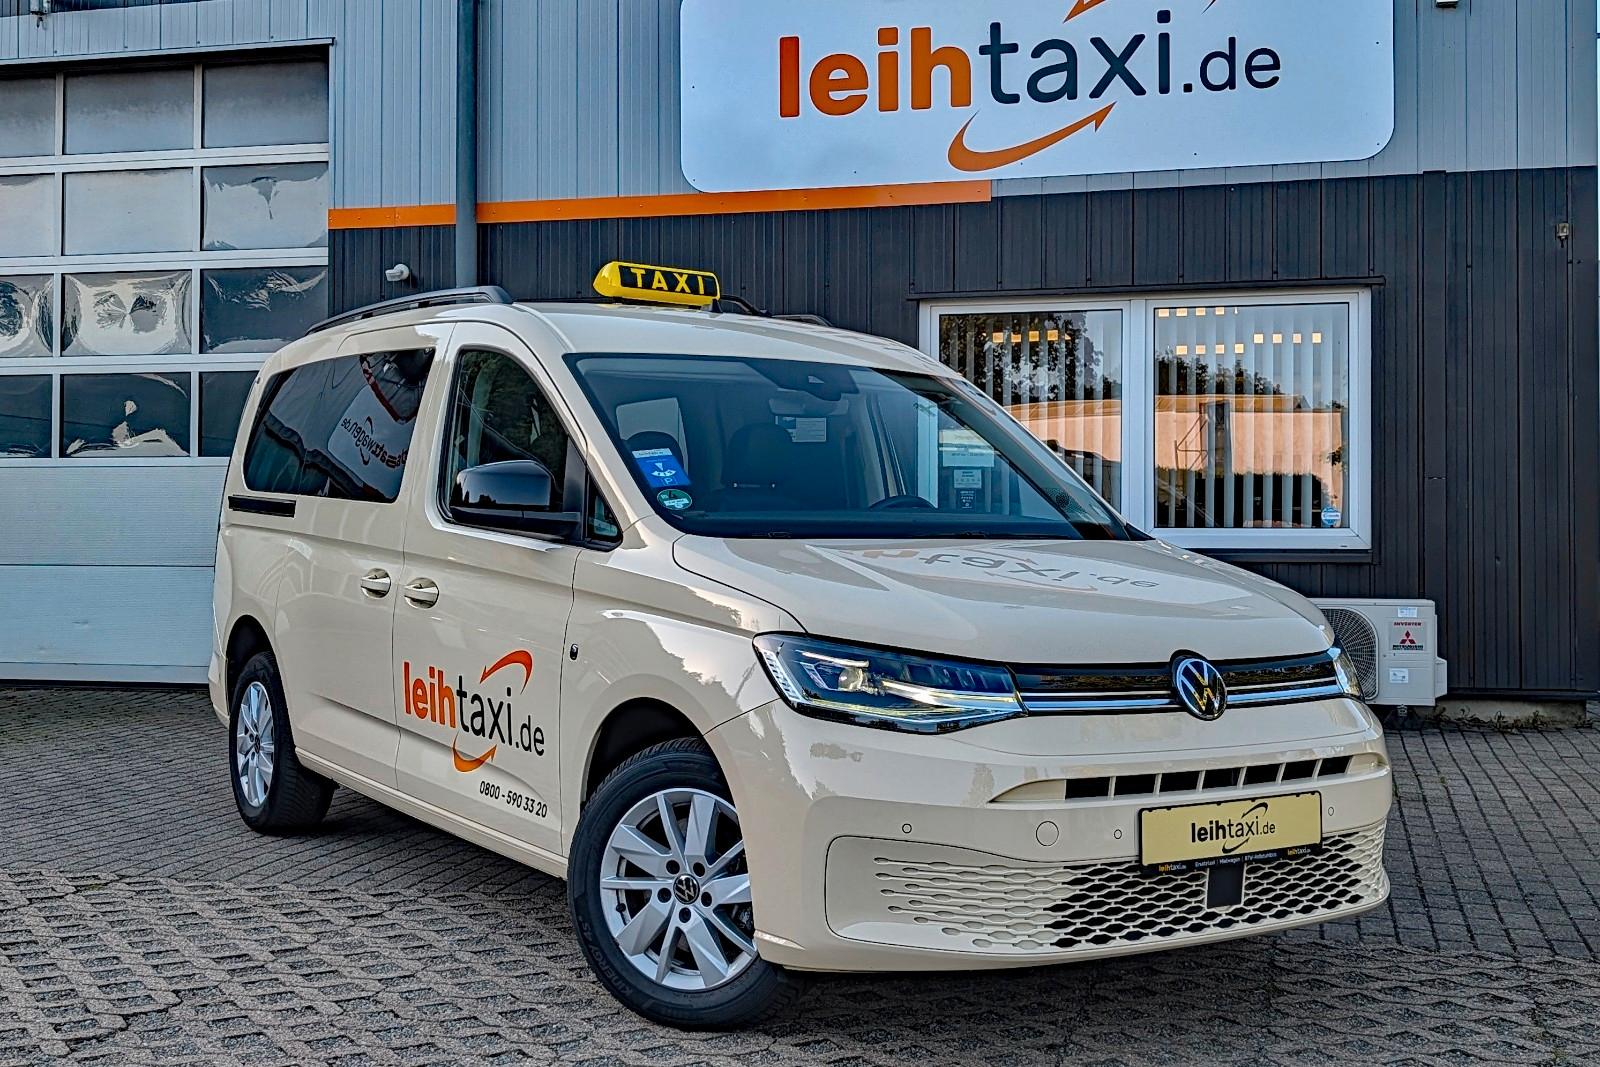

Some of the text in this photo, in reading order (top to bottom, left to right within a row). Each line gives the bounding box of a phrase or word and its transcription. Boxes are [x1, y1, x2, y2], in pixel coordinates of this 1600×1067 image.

[779, 10, 1281, 118] leihtaxi.de
[630, 268, 705, 295] TAXI
[404, 661, 545, 756] leihtaxi.de
[479, 780, 500, 800] 0800
[506, 790, 522, 809] 590
[522, 796, 535, 814] 33
[535, 801, 548, 818] 20
[1191, 815, 1276, 843] leihtaxi.de
